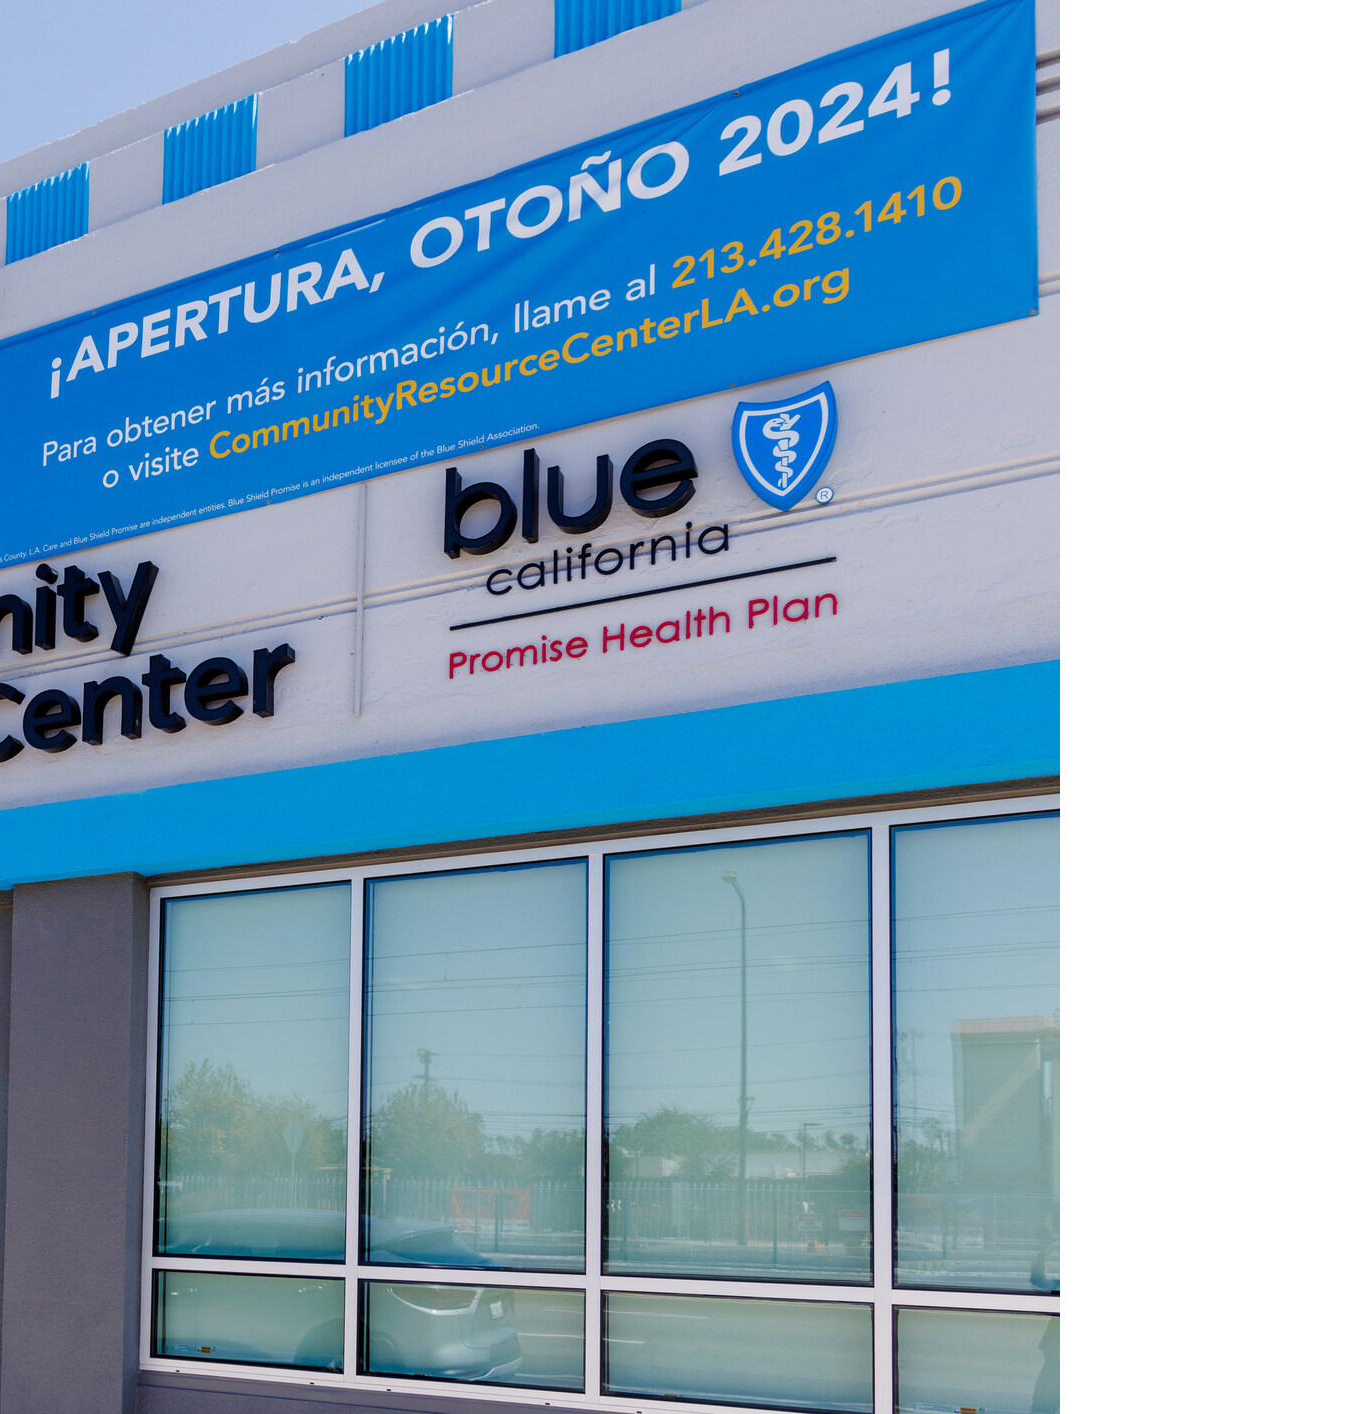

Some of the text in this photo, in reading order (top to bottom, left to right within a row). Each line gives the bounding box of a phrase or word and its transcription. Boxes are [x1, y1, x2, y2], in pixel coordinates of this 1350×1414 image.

[50, 47, 952, 399] ¡APERTURA, OTOÑO 2024!
[42, 175, 963, 467] Para obtener más información, llame al 213.428.1410
[102, 266, 850, 488] o visite CommunityResourceCenterLA.org
[3, 551, 28, 564] County.
[29, 546, 41, 556] L.A.
[42, 543, 59, 552] Care
[59, 538, 73, 549] and
[73, 535, 88, 545] Blue
[89, 529, 111, 541] Shield
[111, 523, 138, 536] Promise
[139, 521, 151, 529] are
[151, 508, 197, 525] independent
[198, 502, 226, 514] entities.
[228, 497, 245, 508] Blue
[246, 489, 269, 503] Shield
[271, 482, 300, 497] Promise
[302, 479, 309, 488] is
[310, 478, 321, 486] an
[321, 464, 373, 483] independent
[375, 455, 408, 469] licensee
[409, 451, 419, 461] of
[420, 448, 435, 459] the
[436, 444, 456, 455] Blue
[457, 435, 485, 449] Shield
[486, 422, 540, 442] Association.
[444, 438, 698, 559] blue
[486, 522, 730, 596] california
[449, 592, 838, 680] Promise Health Plan
